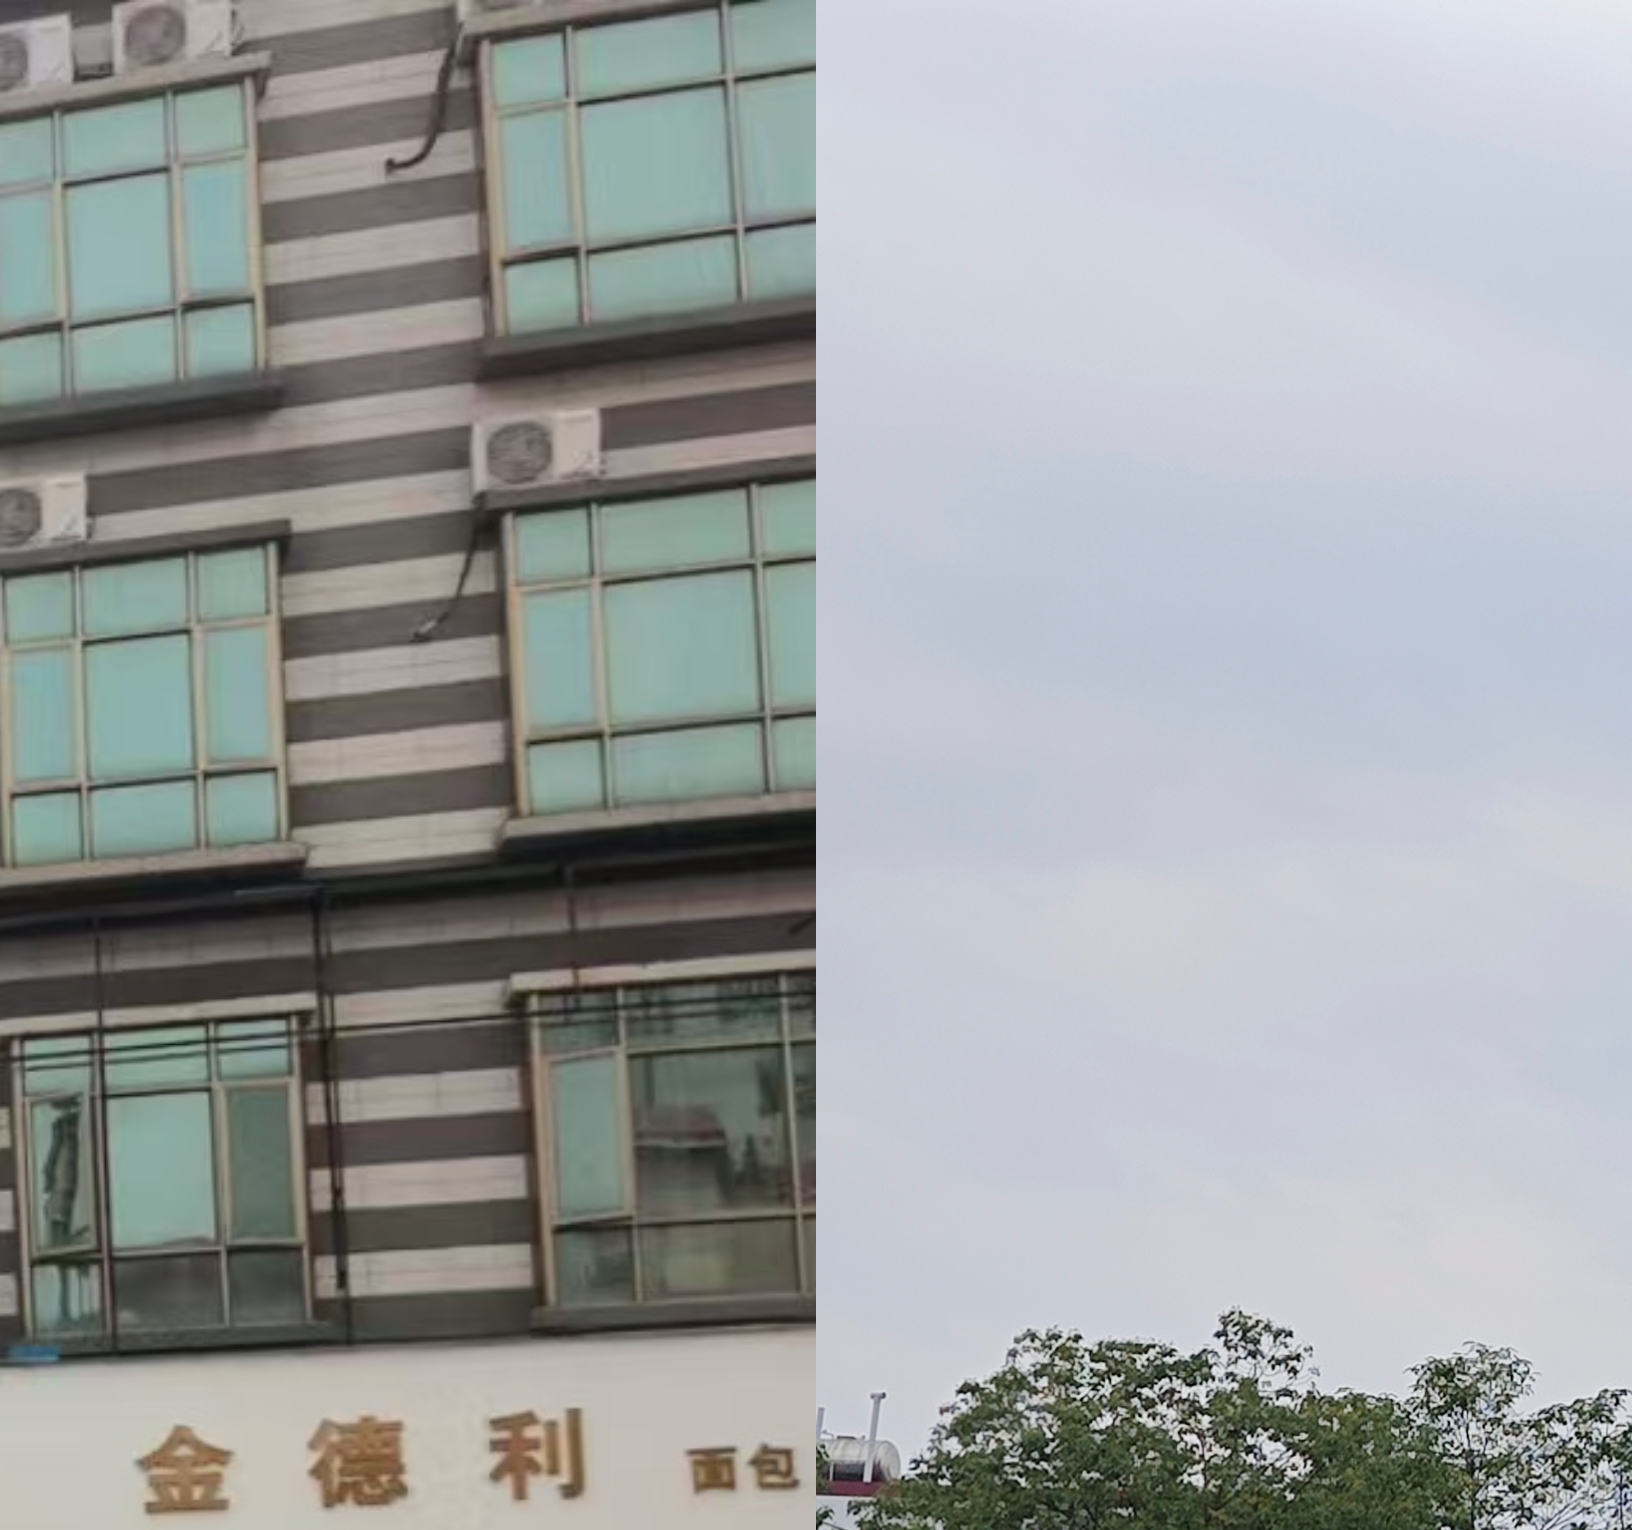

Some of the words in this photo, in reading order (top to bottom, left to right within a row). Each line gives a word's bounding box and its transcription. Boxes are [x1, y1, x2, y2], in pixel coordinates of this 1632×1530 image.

[134, 1406, 586, 1514] 金德利
[685, 1442, 801, 1494] 面包
